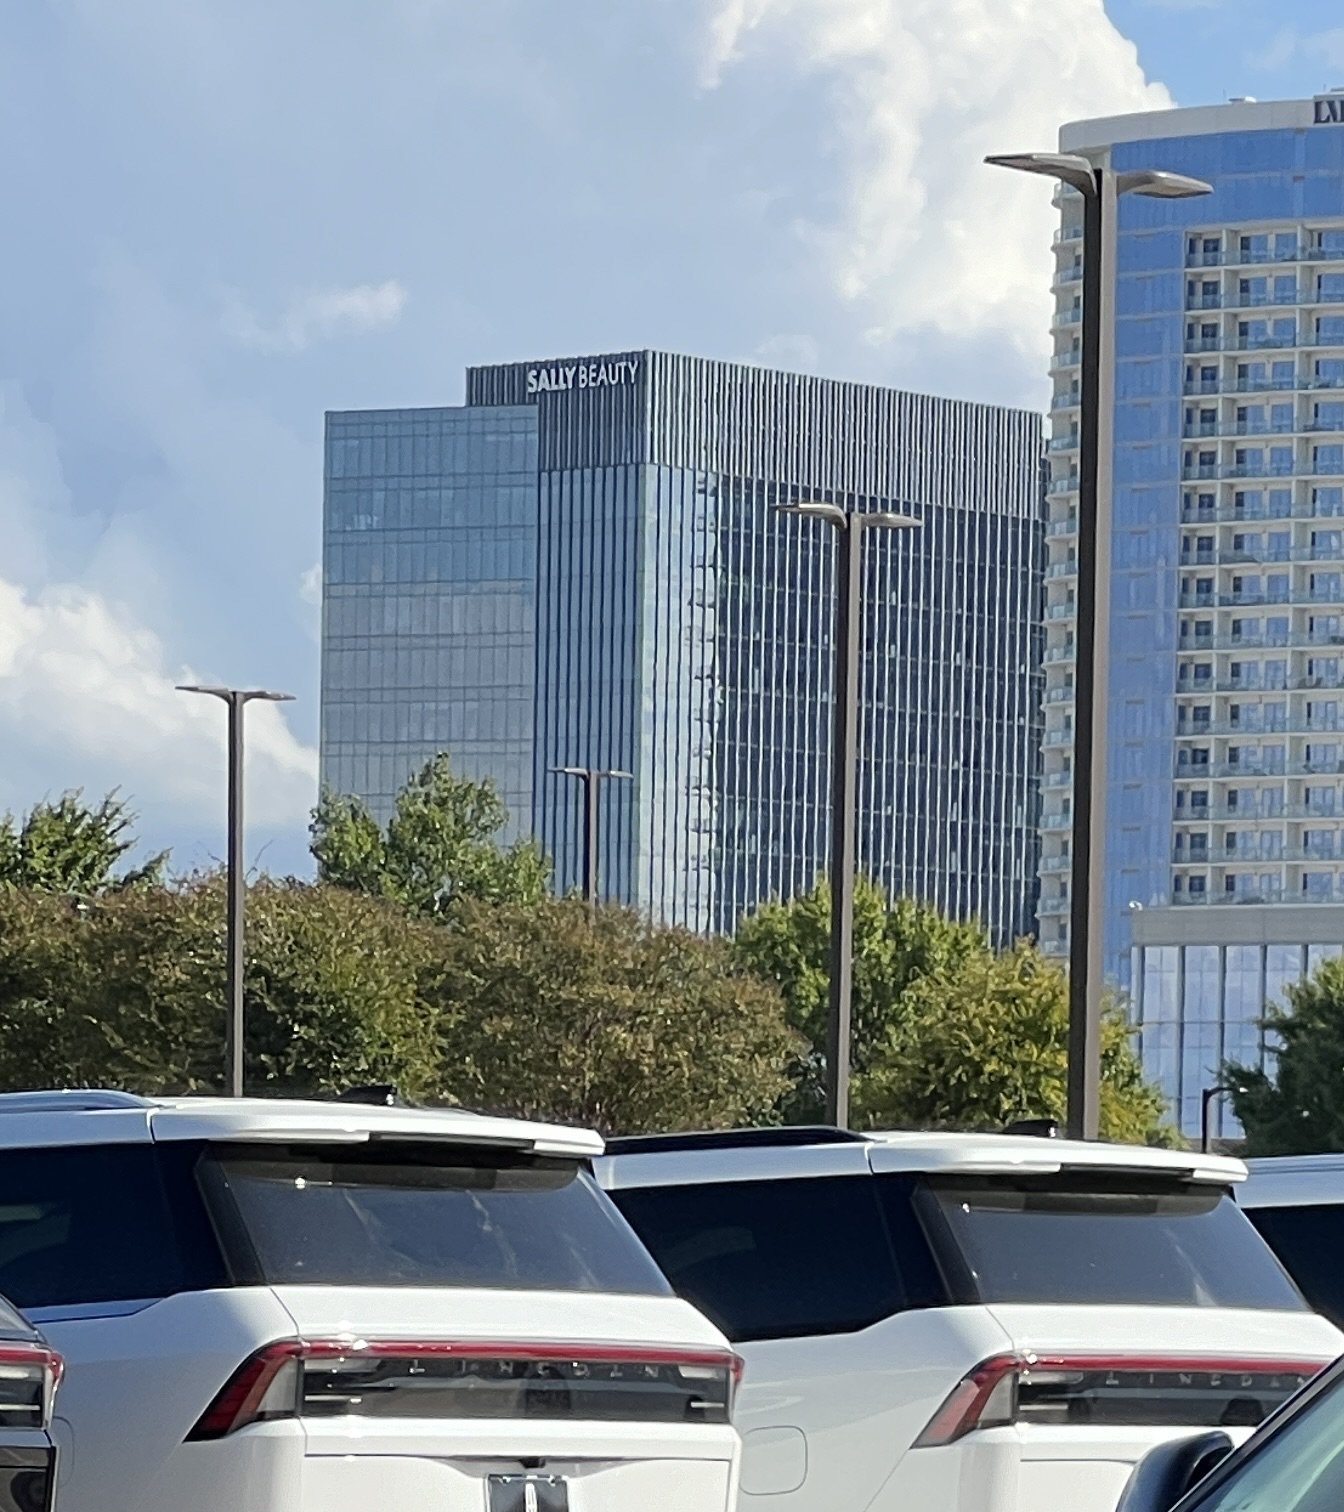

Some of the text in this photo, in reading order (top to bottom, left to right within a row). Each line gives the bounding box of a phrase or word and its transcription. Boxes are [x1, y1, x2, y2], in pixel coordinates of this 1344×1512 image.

[528, 361, 638, 393] SALLY BEAUTY
[409, 1359, 659, 1379] LINCOLN
